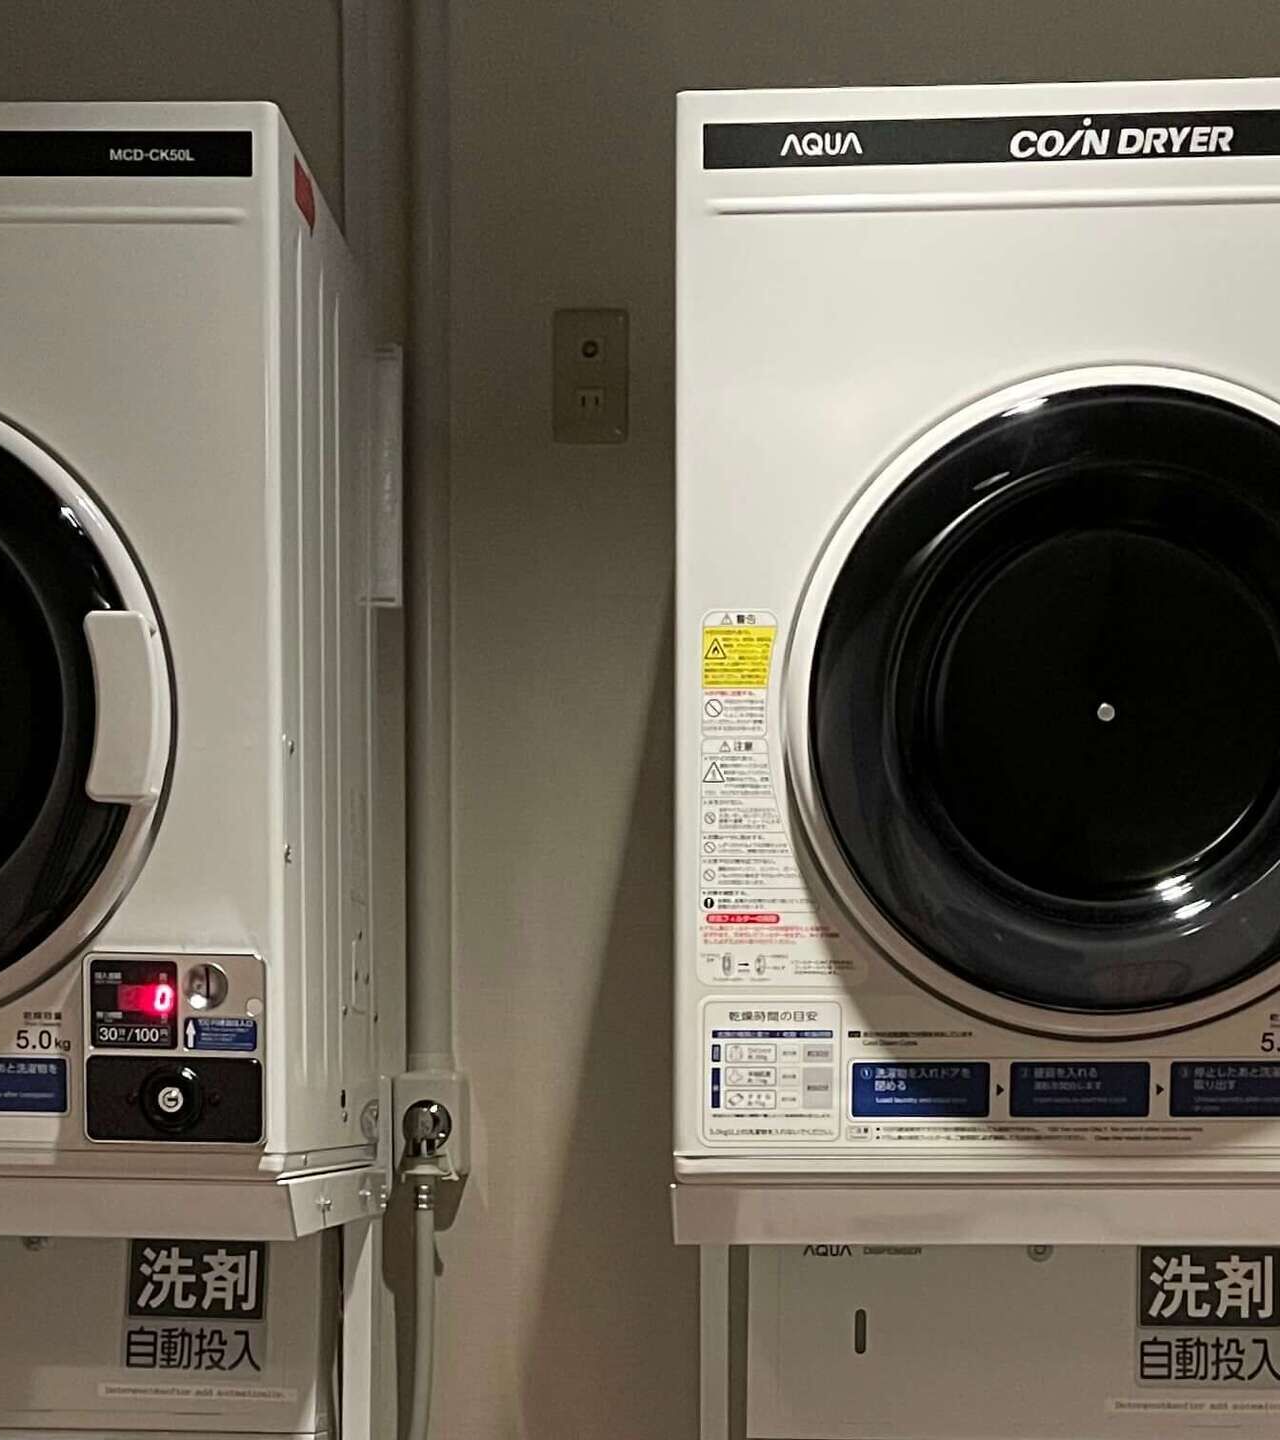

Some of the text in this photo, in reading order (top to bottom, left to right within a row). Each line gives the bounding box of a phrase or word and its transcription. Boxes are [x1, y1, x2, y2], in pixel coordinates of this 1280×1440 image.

[109, 147, 195, 163] MCD-CK50L
[780, 132, 863, 156] AQUA
[1010, 117, 1235, 160] COIN DRYER
[154, 984, 174, 1012] 0
[137, 1247, 259, 1311] 洗剤
[1148, 1255, 1274, 1319] 洗剤
[125, 1324, 263, 1373] 自動投入
